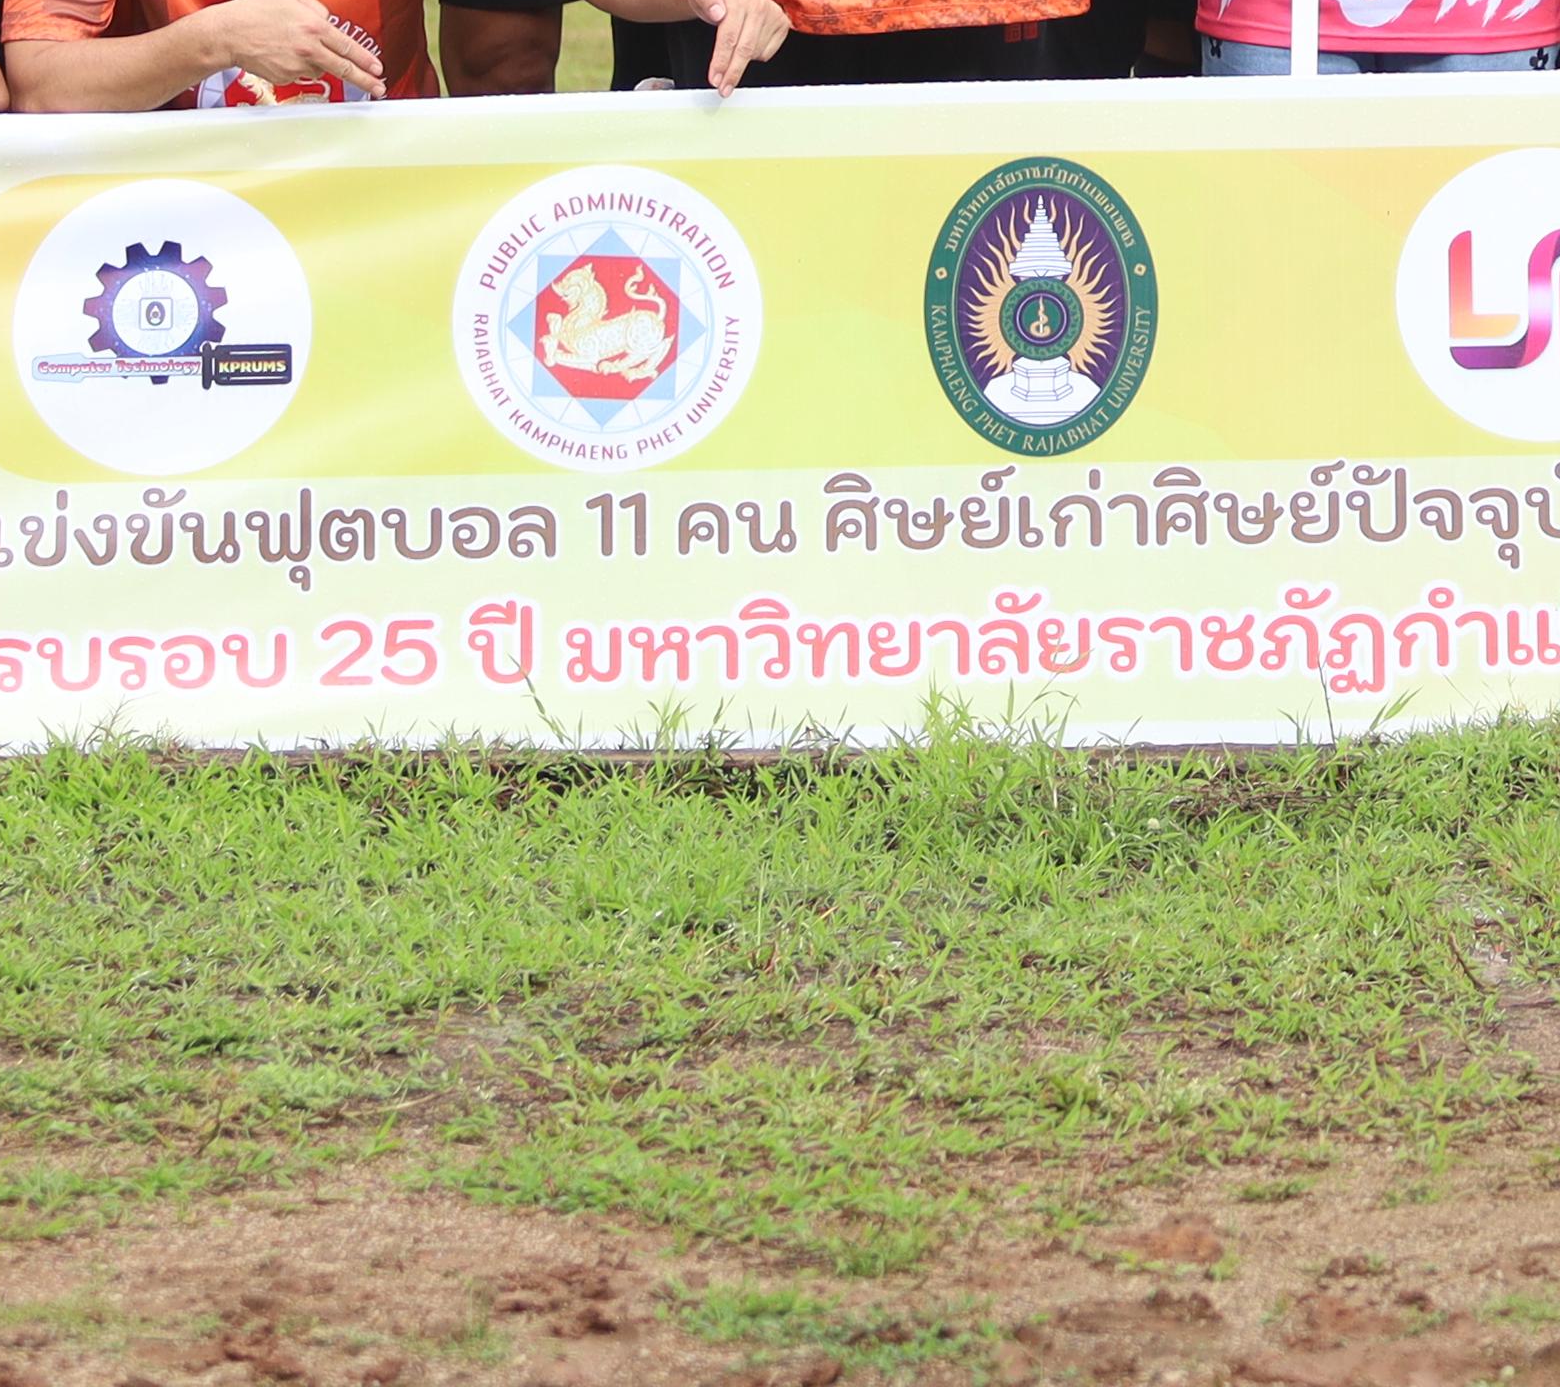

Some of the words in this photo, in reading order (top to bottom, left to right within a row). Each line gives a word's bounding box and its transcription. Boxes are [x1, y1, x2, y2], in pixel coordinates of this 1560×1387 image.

[479, 213, 545, 291] PUBLIC
[552, 192, 736, 290] ADMINISTRATION
[38, 361, 112, 376] Computer
[115, 359, 201, 376] Technology
[218, 360, 287, 375] KPRUMS
[473, 313, 512, 410] RAJABHAT
[509, 408, 628, 461] KAMPHAENG
[636, 422, 685, 455] PHET
[685, 315, 740, 425] UNIVERSITY
[931, 304, 979, 414] KAMPHAENG
[974, 411, 1020, 446] PHET
[1022, 408, 1112, 455] RAJABHAT
[1107, 305, 1152, 410] UNIVERSITY
[586, 492, 648, 558] 11
[677, 501, 798, 556] คน
[319, 618, 439, 688] 25
[467, 599, 535, 685] ปี
